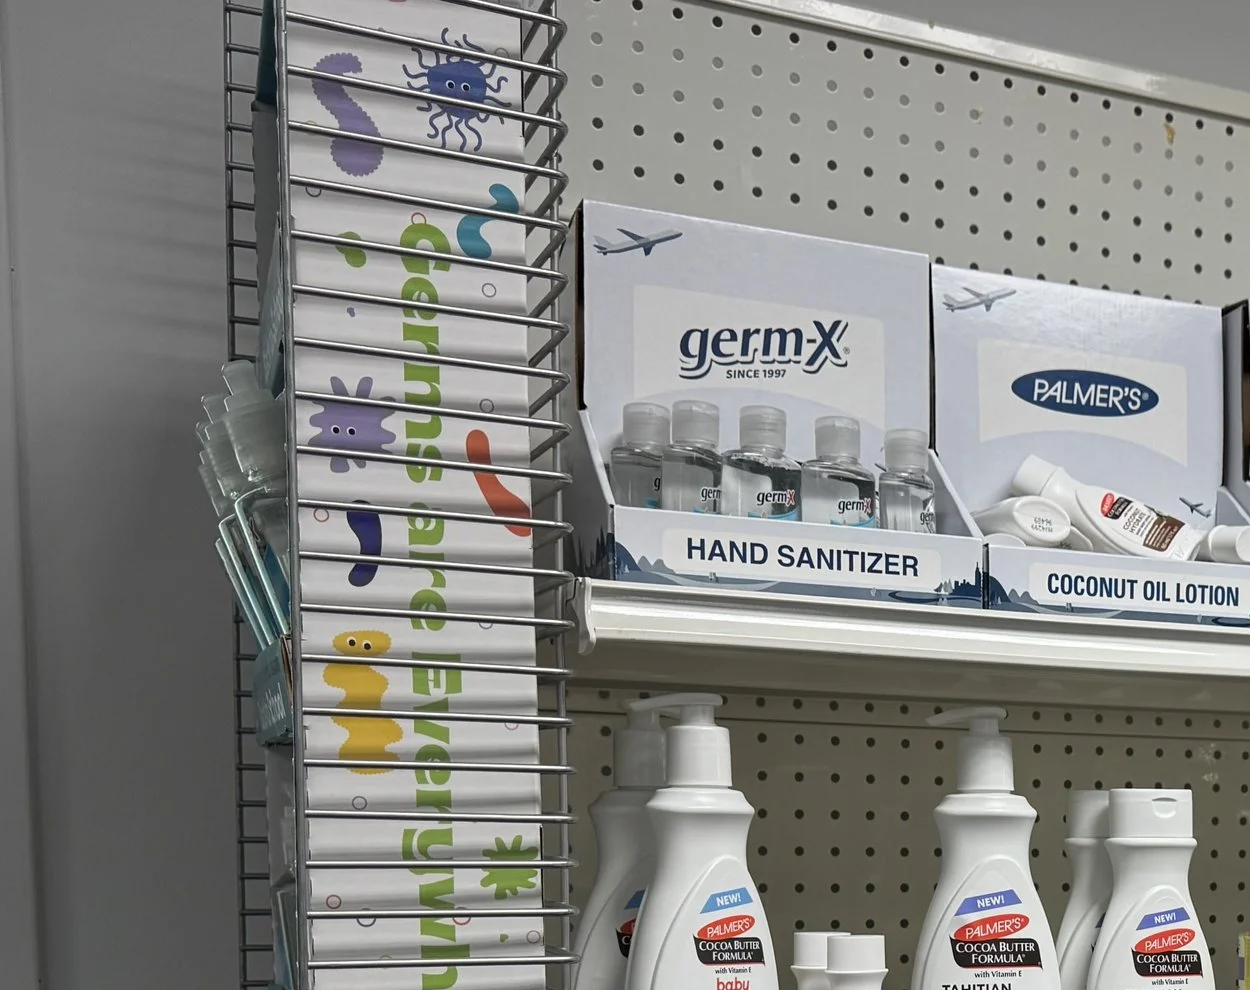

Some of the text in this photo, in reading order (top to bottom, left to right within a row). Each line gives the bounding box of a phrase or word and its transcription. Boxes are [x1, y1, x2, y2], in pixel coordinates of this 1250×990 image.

[400, 222, 451, 483] Germs
[726, 369, 786, 379] SINCE 1997
[1033, 379, 1141, 413] PALMER'S
[687, 538, 918, 576] HAND SANITIZER
[408, 502, 447, 631] are
[1048, 573, 1239, 606] COCONUT OIL LOTION
[716, 894, 741, 906] NEW!
[977, 896, 1004, 908] NEW!
[1154, 913, 1177, 924] NEW!
[707, 918, 749, 938] PALMER'S
[966, 918, 1021, 939] PALMER'S
[699, 941, 760, 950] COCOA BUTTER
[1145, 932, 1190, 951] PALMER'S
[956, 943, 1034, 953] COCOA BUTTER
[712, 951, 752, 961] FORMULA
[972, 954, 1023, 963] FORMULA
[1137, 954, 1198, 963] COCOA BUTTER
[990, 970, 1016, 978] Vitamin
[1150, 964, 1189, 973] FORMULA
